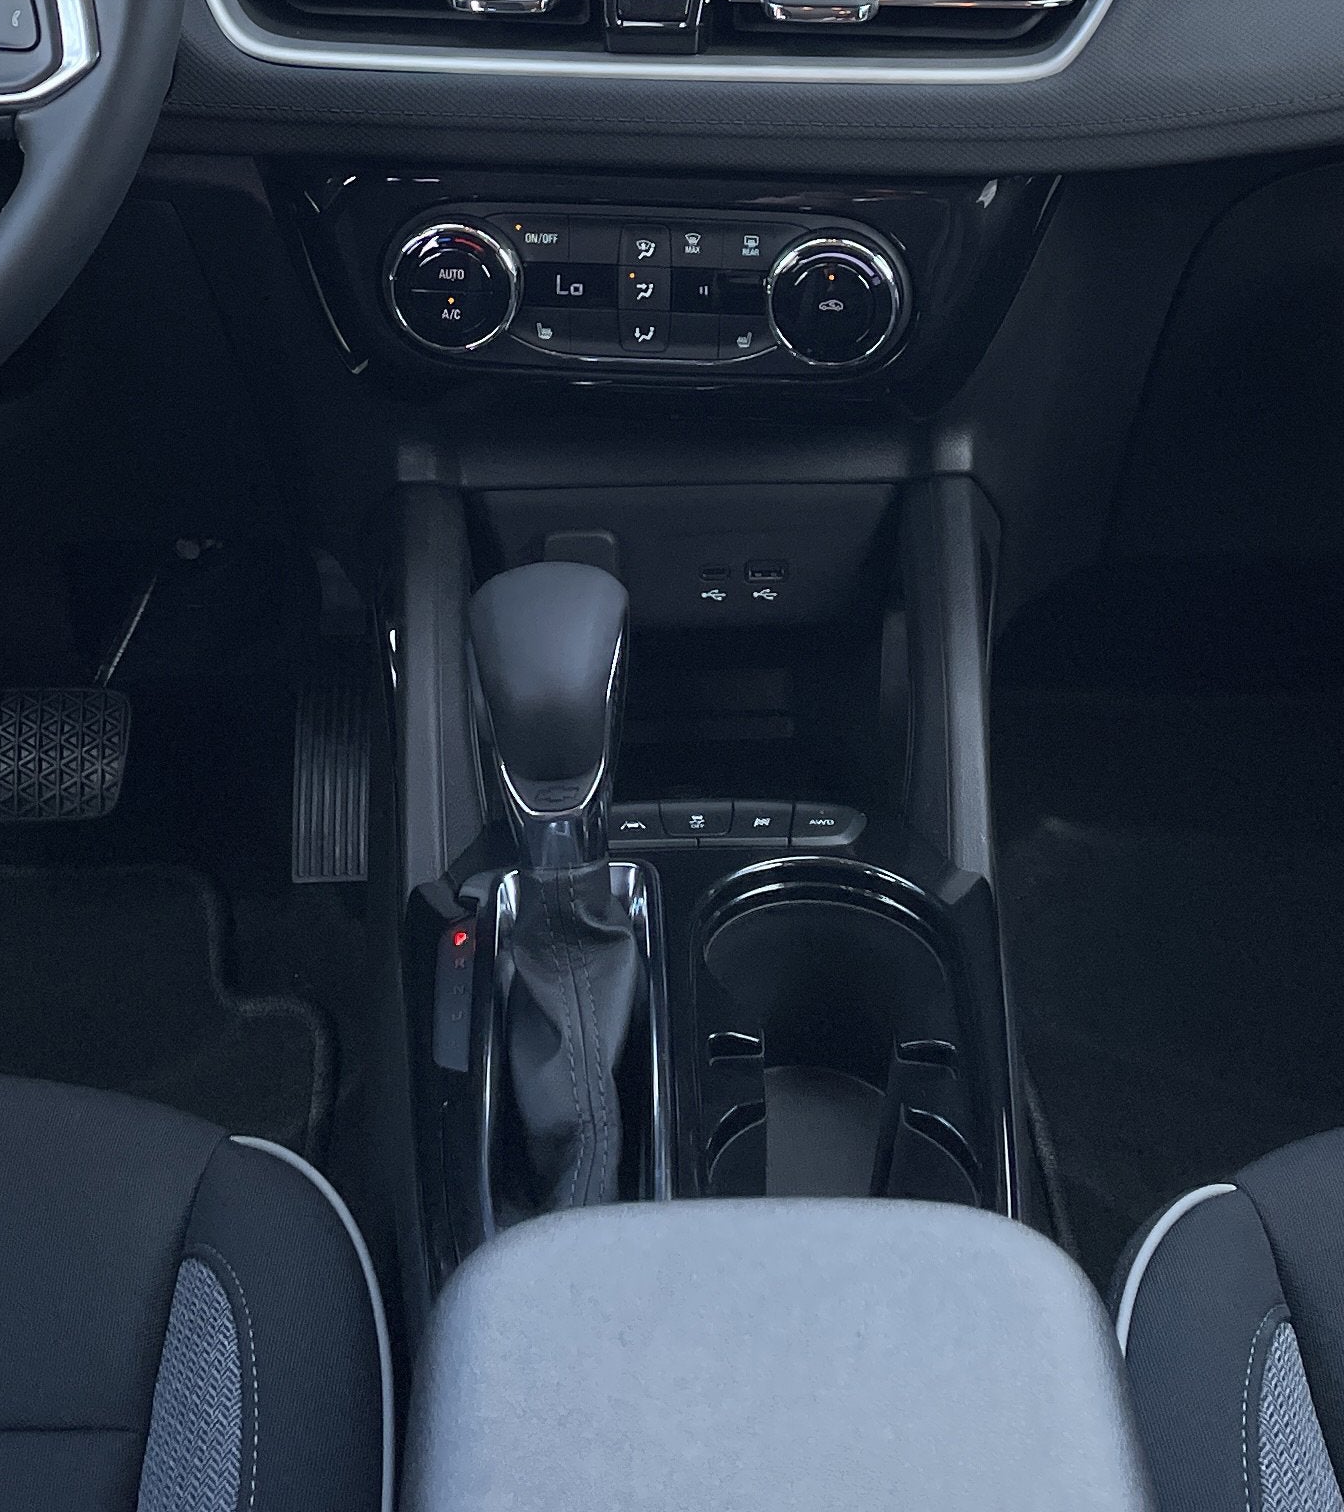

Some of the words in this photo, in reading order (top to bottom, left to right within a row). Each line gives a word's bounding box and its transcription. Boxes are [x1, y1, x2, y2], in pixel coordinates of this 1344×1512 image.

[525, 233, 559, 244] ON/OFF
[684, 243, 701, 254] MAX
[741, 245, 760, 256] REAR
[438, 268, 465, 282] AUTO
[442, 308, 462, 320] A/C
